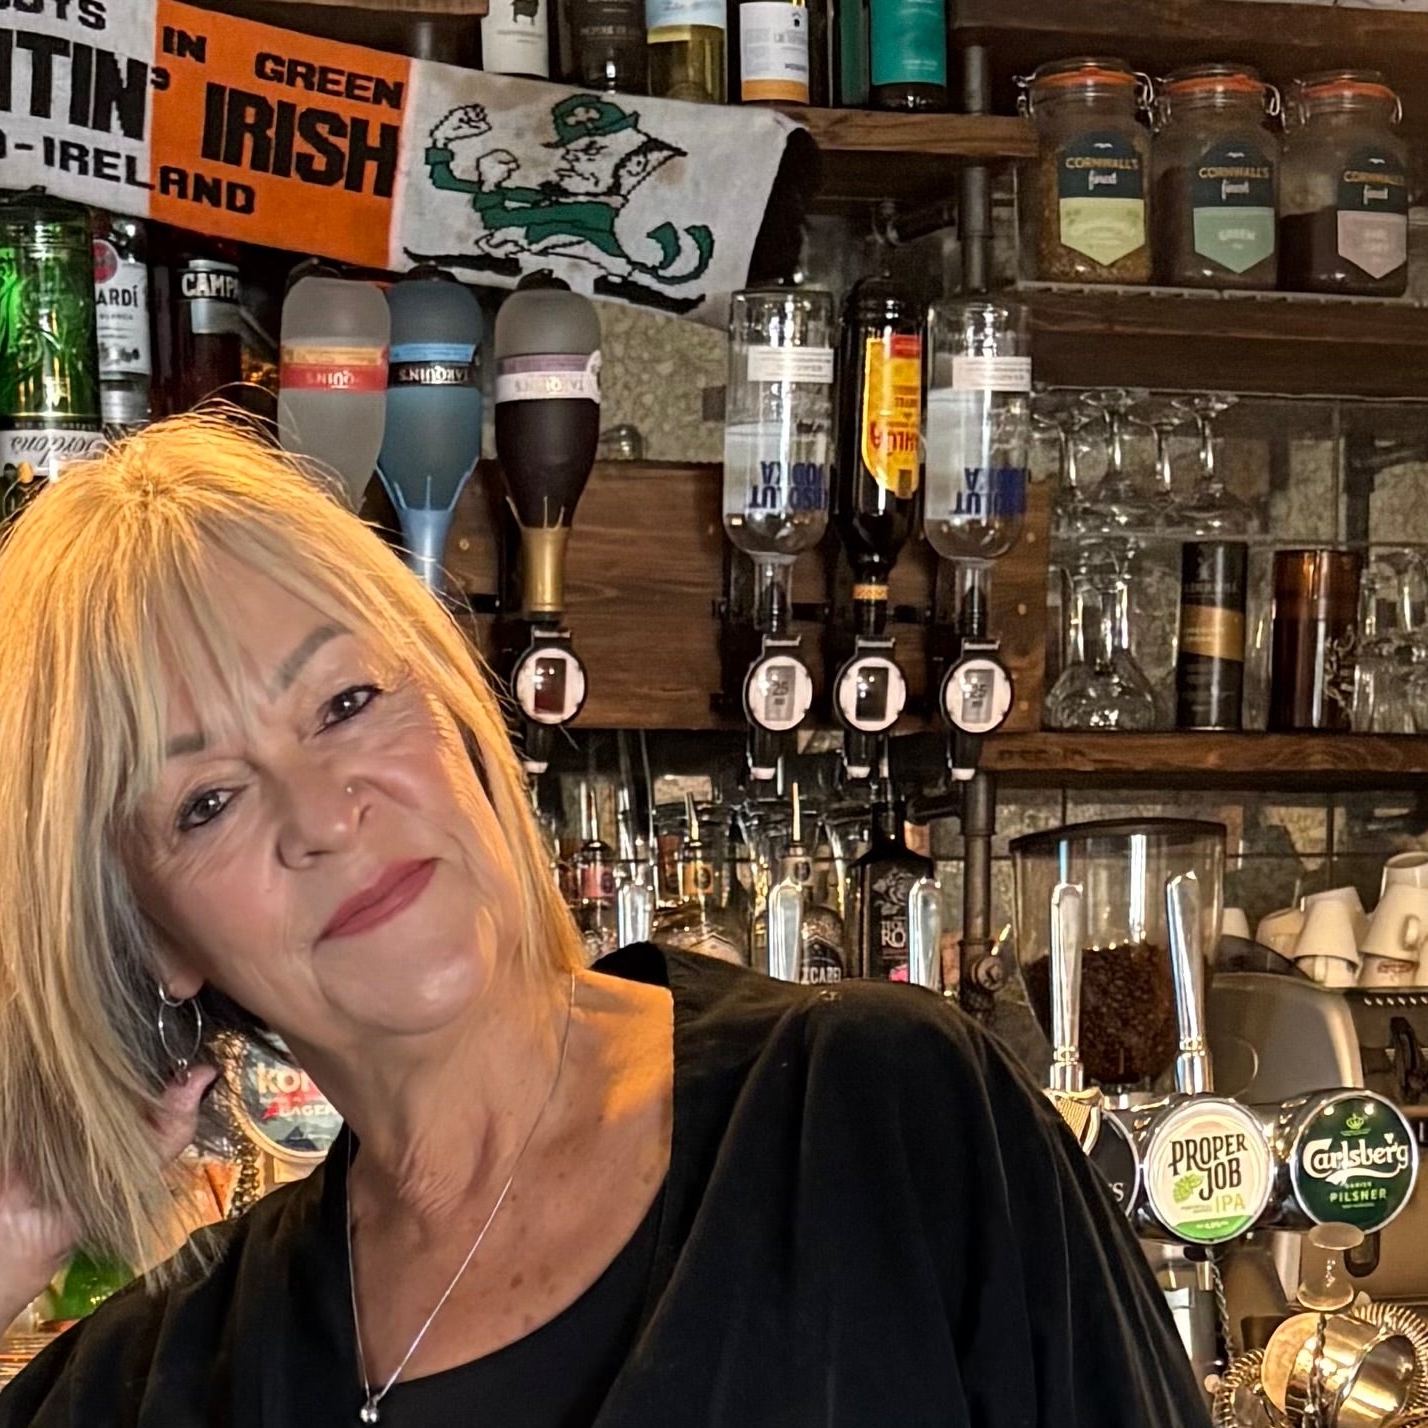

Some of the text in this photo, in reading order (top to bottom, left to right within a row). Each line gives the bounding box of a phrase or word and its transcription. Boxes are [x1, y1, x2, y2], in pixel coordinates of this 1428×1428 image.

[162, 26, 207, 64] IN
[254, 52, 405, 110] GREEN
[200, 81, 401, 199] IRISH
[95, 285, 139, 308] ARDÍ
[1168, 1132, 1249, 1177] PROPER
[1302, 1133, 1409, 1185] Carlsberg
[1199, 1156, 1243, 1201] JOB
[1329, 1187, 1388, 1203] PILSNER
[1214, 1193, 1246, 1214] IPA
